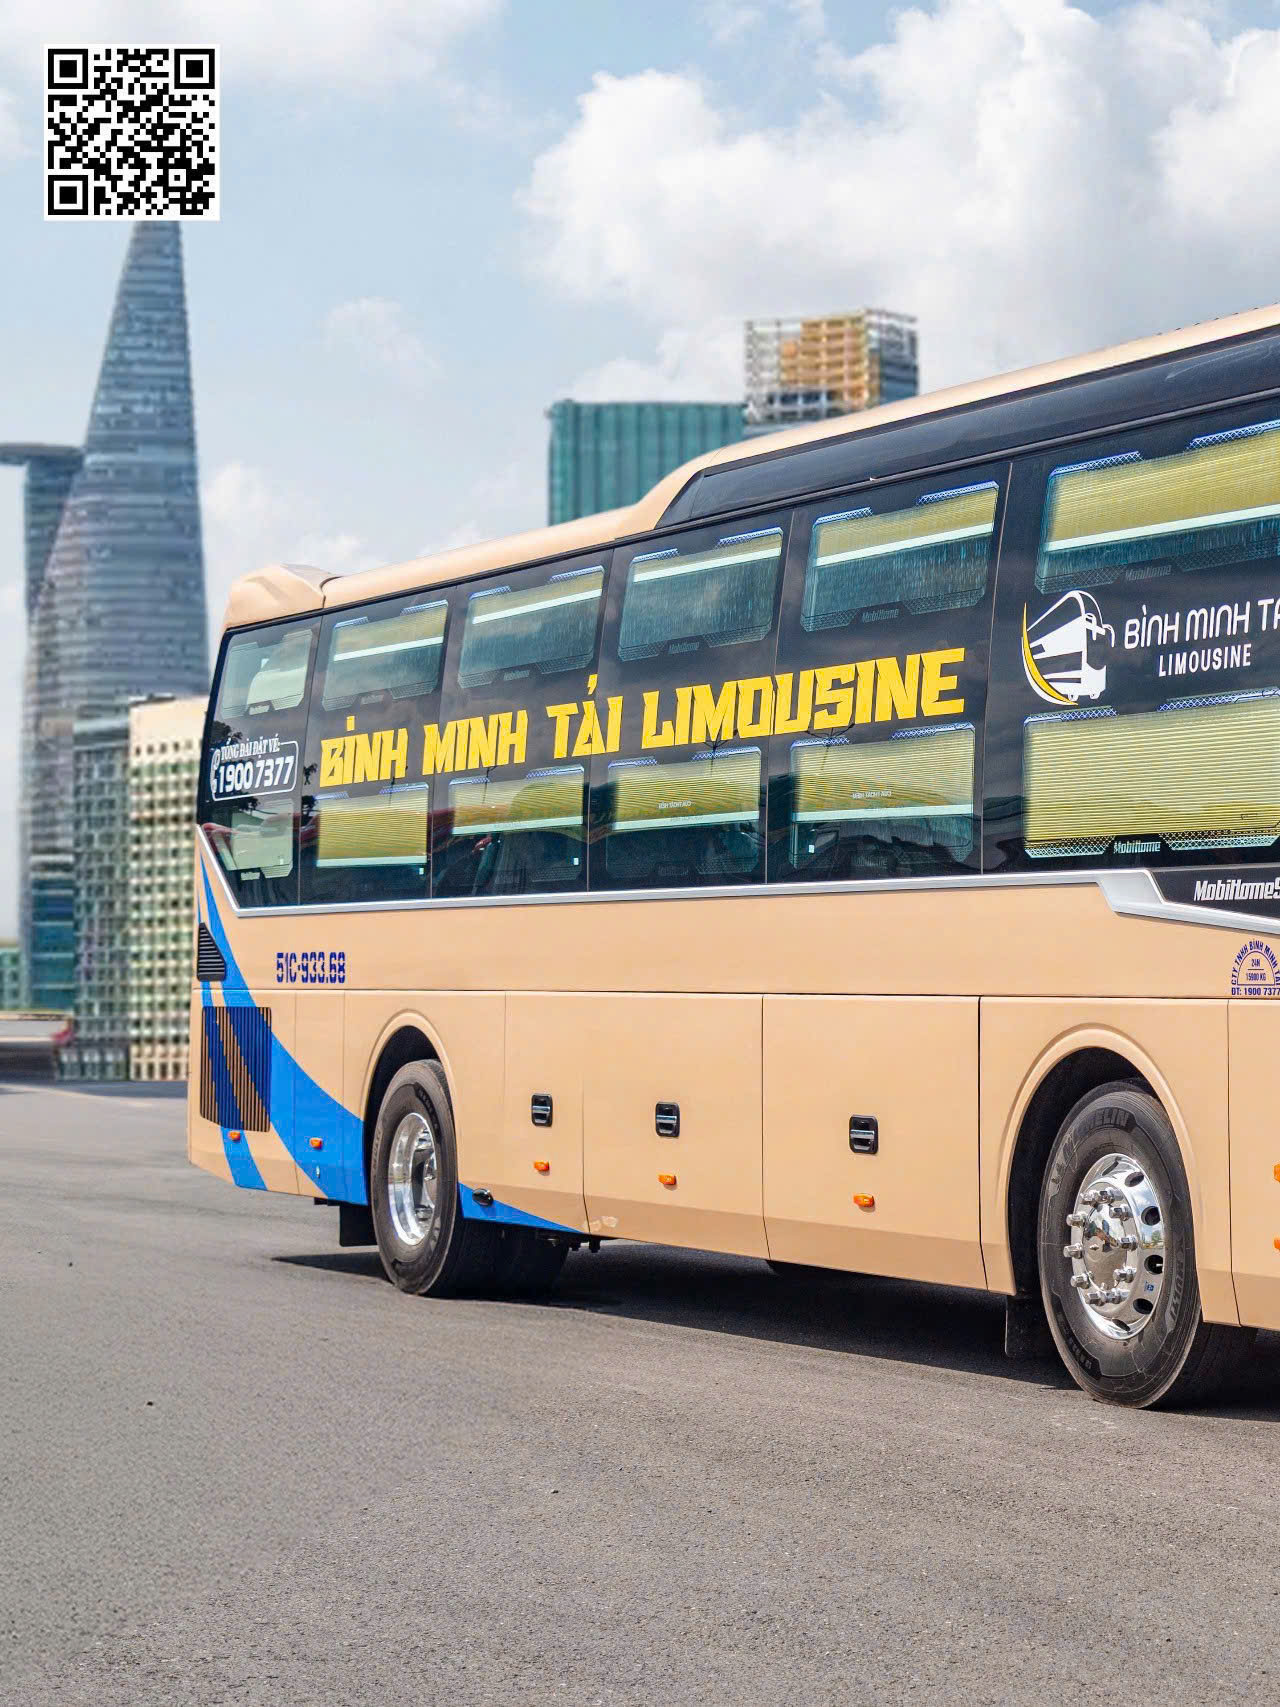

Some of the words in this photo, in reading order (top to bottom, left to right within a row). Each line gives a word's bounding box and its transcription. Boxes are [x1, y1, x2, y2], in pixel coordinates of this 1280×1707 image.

[1124, 604, 1179, 649] BÌNH
[1185, 601, 1250, 641] MINH
[1158, 643, 1252, 677] LIMOUSINE
[422, 709, 528, 775] MINH
[641, 647, 965, 749] LIMOUSINE
[219, 761, 253, 793] 1900
[254, 756, 294, 788] 7377
